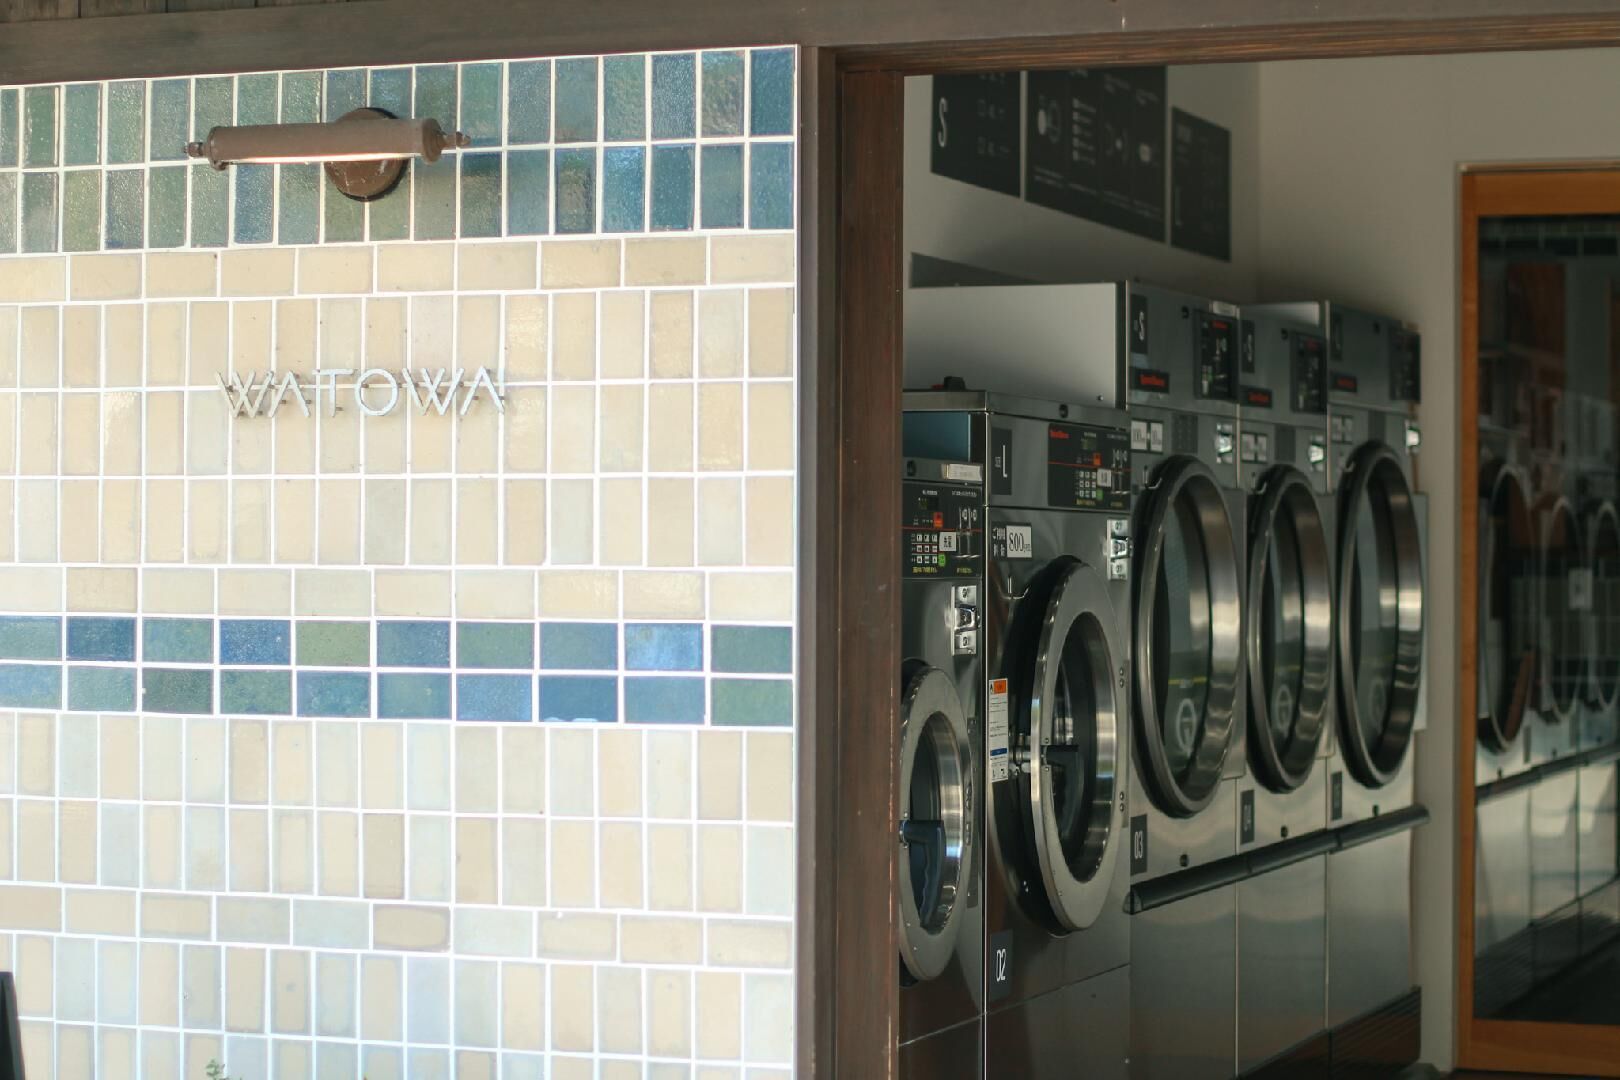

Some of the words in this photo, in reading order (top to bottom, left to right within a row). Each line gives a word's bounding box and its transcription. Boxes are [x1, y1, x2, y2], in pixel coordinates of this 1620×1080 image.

[214, 365, 505, 419] WATOWA
[1134, 830, 1144, 860] 03
[996, 948, 1007, 982] 02
